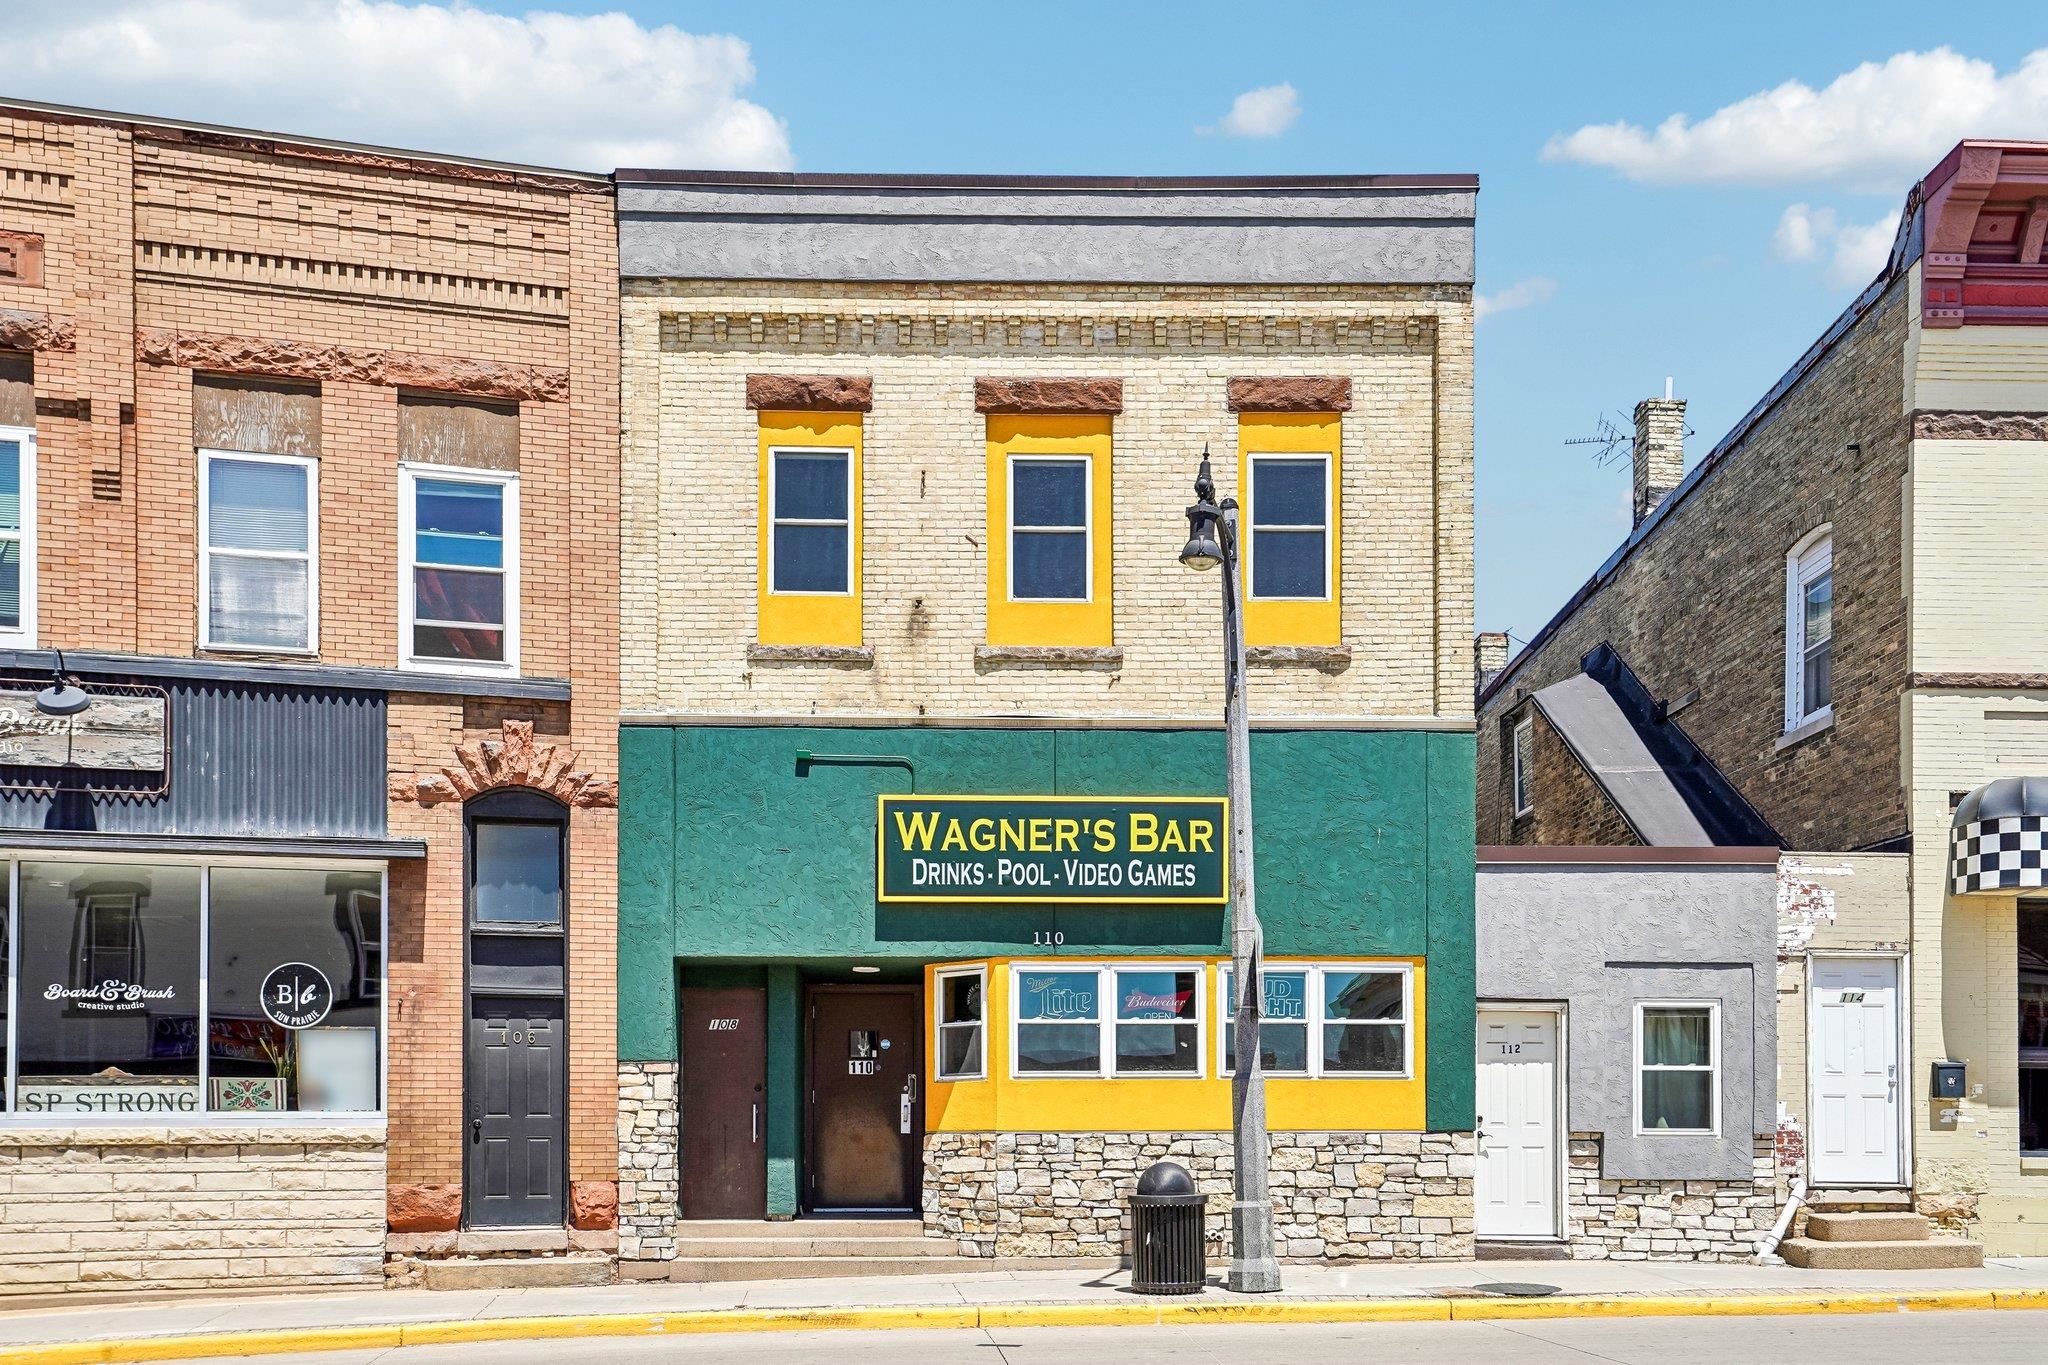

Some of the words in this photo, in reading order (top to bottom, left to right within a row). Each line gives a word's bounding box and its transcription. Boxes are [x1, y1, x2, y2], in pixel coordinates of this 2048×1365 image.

[893, 811, 1117, 853] WAGNER'S
[1129, 813, 1215, 853] BAR
[912, 858, 985, 886] DRINKS
[998, 858, 1052, 887] POOL
[1063, 859, 1123, 887] VIDEO
[1128, 859, 1196, 887] GAMES
[1033, 931, 1064, 945] 110
[43, 983, 100, 1000] Board
[123, 984, 176, 1001] Brush
[1841, 992, 1866, 1003] 114
[77, 1001, 115, 1011] creative
[116, 1001, 146, 1011] studio
[1038, 988, 1092, 1019] Lite
[1125, 995, 1187, 1008] Budweiser
[273, 1010, 291, 1024] SUN
[290, 1009, 321, 1026] PRAIRIE
[711, 1019, 739, 1030] 108
[501, 1031, 536, 1045] 106
[1501, 1044, 1521, 1054] 112
[850, 1061, 873, 1074] 110
[25, 1092, 63, 1112] SP
[75, 1092, 197, 1112] STRONG
